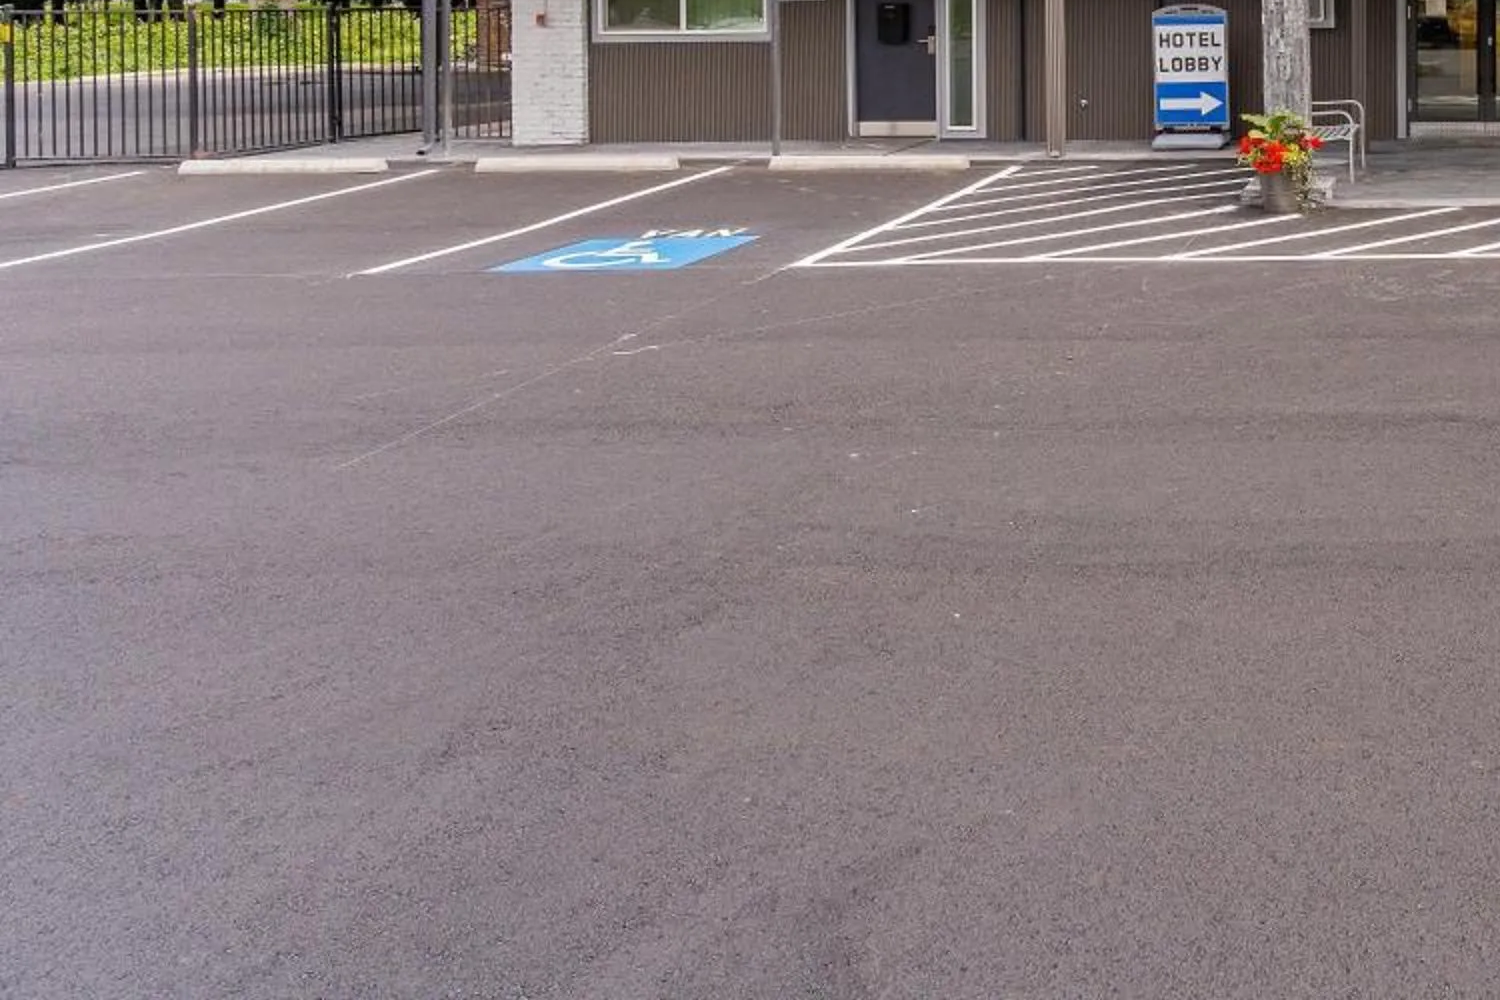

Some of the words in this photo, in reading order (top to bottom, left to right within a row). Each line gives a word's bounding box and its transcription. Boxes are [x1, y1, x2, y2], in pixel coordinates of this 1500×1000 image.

[1159, 32, 1222, 48] HOTEL
[1159, 56, 1222, 72] LOBBY
[640, 227, 749, 239] VAN
